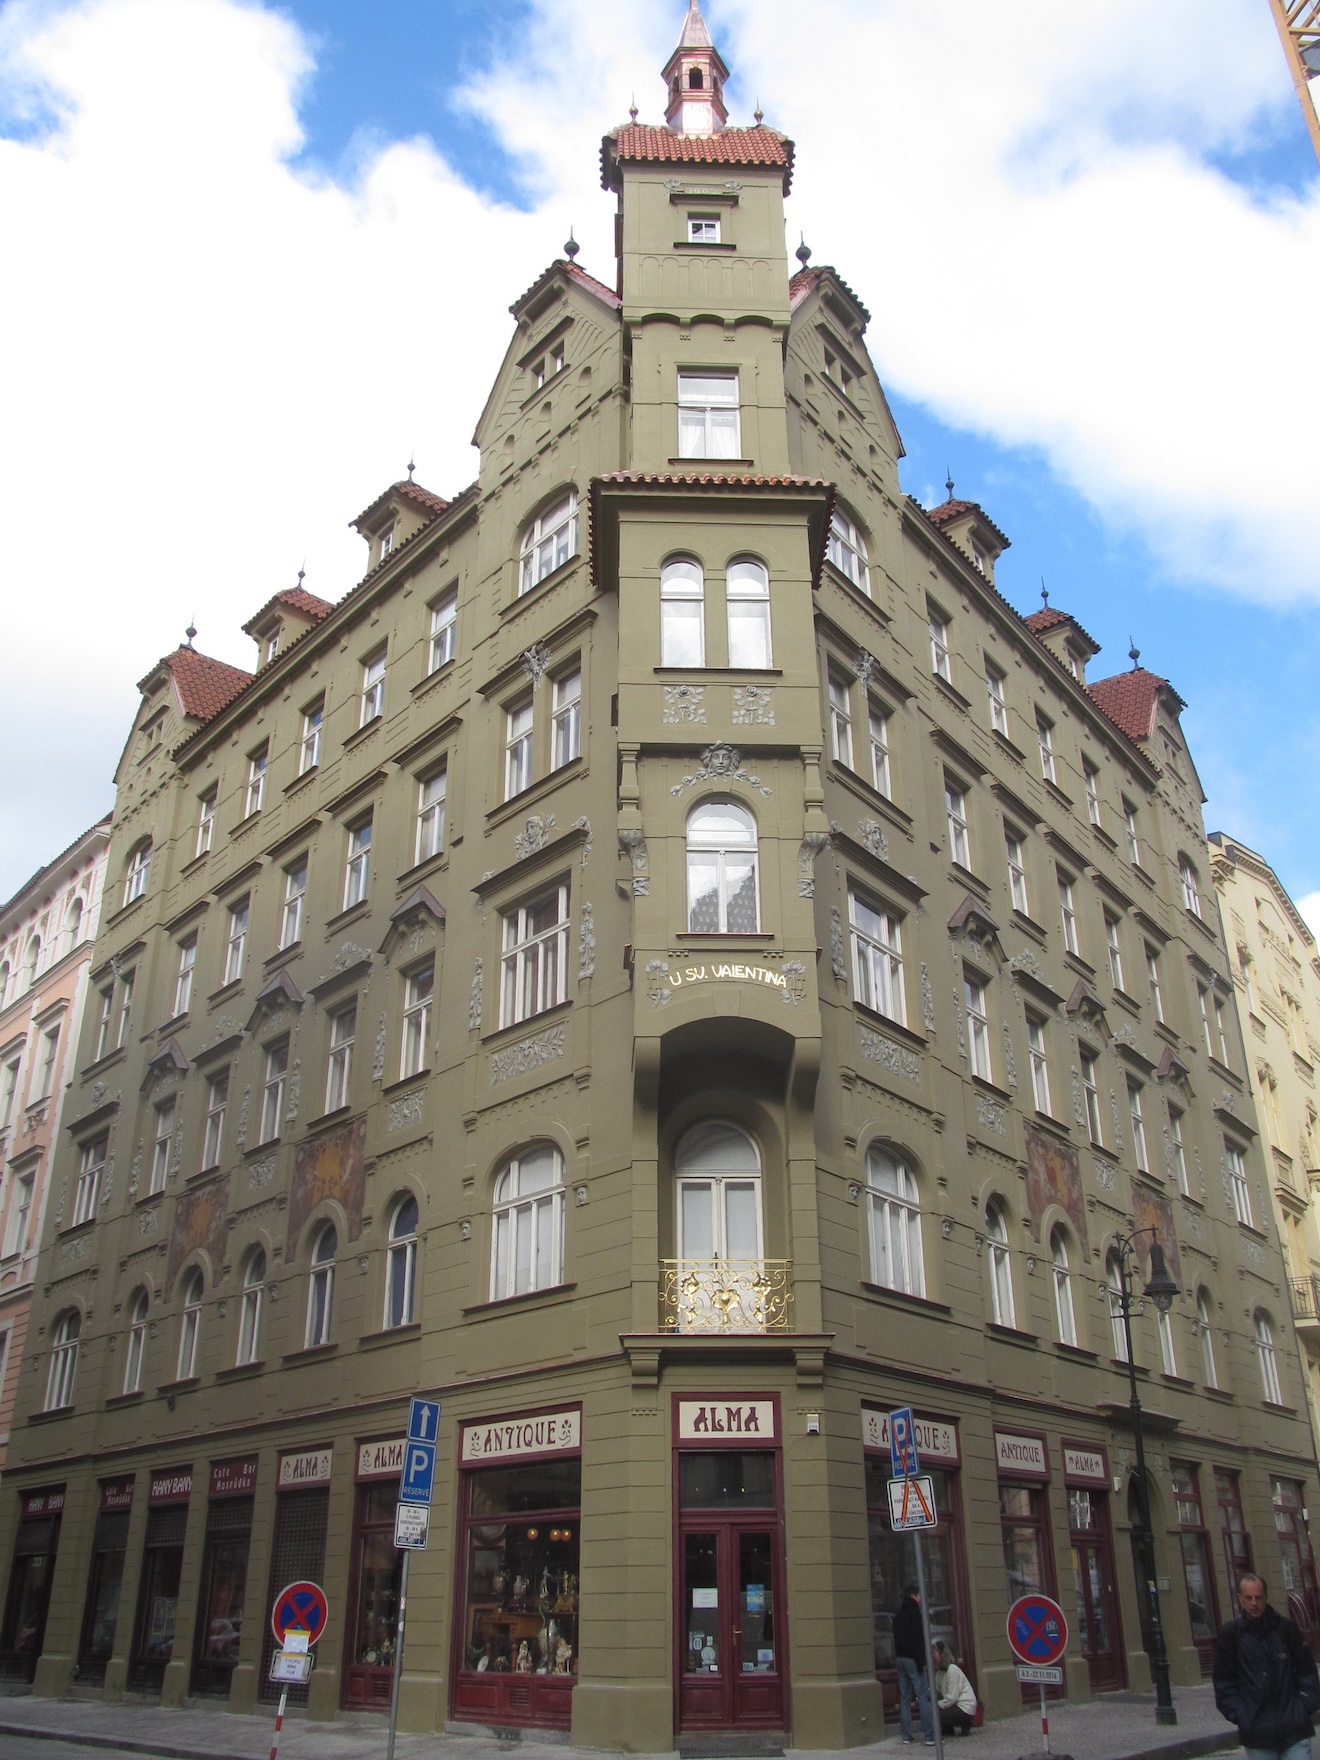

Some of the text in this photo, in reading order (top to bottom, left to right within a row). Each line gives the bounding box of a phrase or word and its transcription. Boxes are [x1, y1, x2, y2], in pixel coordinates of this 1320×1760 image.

[669, 964, 787, 988] U SV. VALENTINA
[693, 1407, 760, 1432] ALMA
[483, 1420, 557, 1453] ANTIQUE
[373, 1444, 403, 1468] ALMA
[1001, 1442, 1041, 1463] ANTIQUE
[1075, 1455, 1095, 1472] ALMA
[243, 1463, 256, 1474] Bar
[292, 1456, 318, 1479] ALMA
[409, 1450, 429, 1483] P
[152, 1479, 173, 1496] HANY
